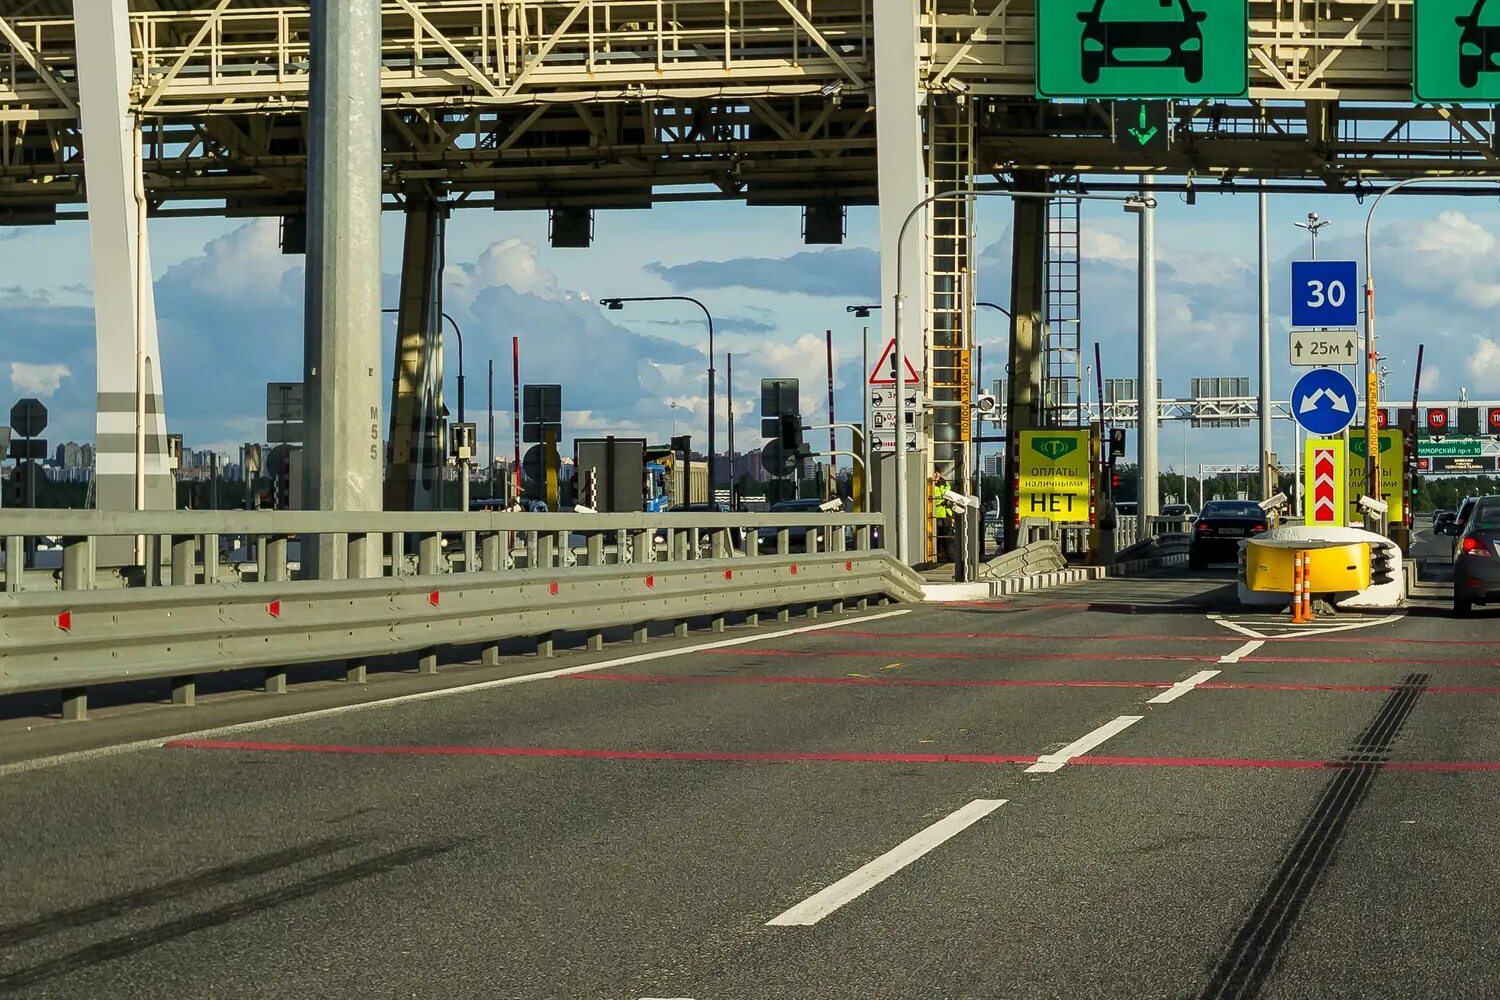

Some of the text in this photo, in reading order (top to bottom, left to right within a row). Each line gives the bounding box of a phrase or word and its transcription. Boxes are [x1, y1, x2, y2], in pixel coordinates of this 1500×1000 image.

[1306, 280, 1346, 308] 30
[1310, 341, 1340, 355] 25м
[961, 357, 969, 434] ПОЛОСА ЗАКРЫТА
[1369, 381, 1377, 420] ЗАКРЫТА
[1432, 414, 1443, 423] 110
[1030, 467, 1078, 477] ОПЛАТЫ
[1025, 480, 1083, 488] наличными
[1030, 492, 1078, 512] НЕТ
